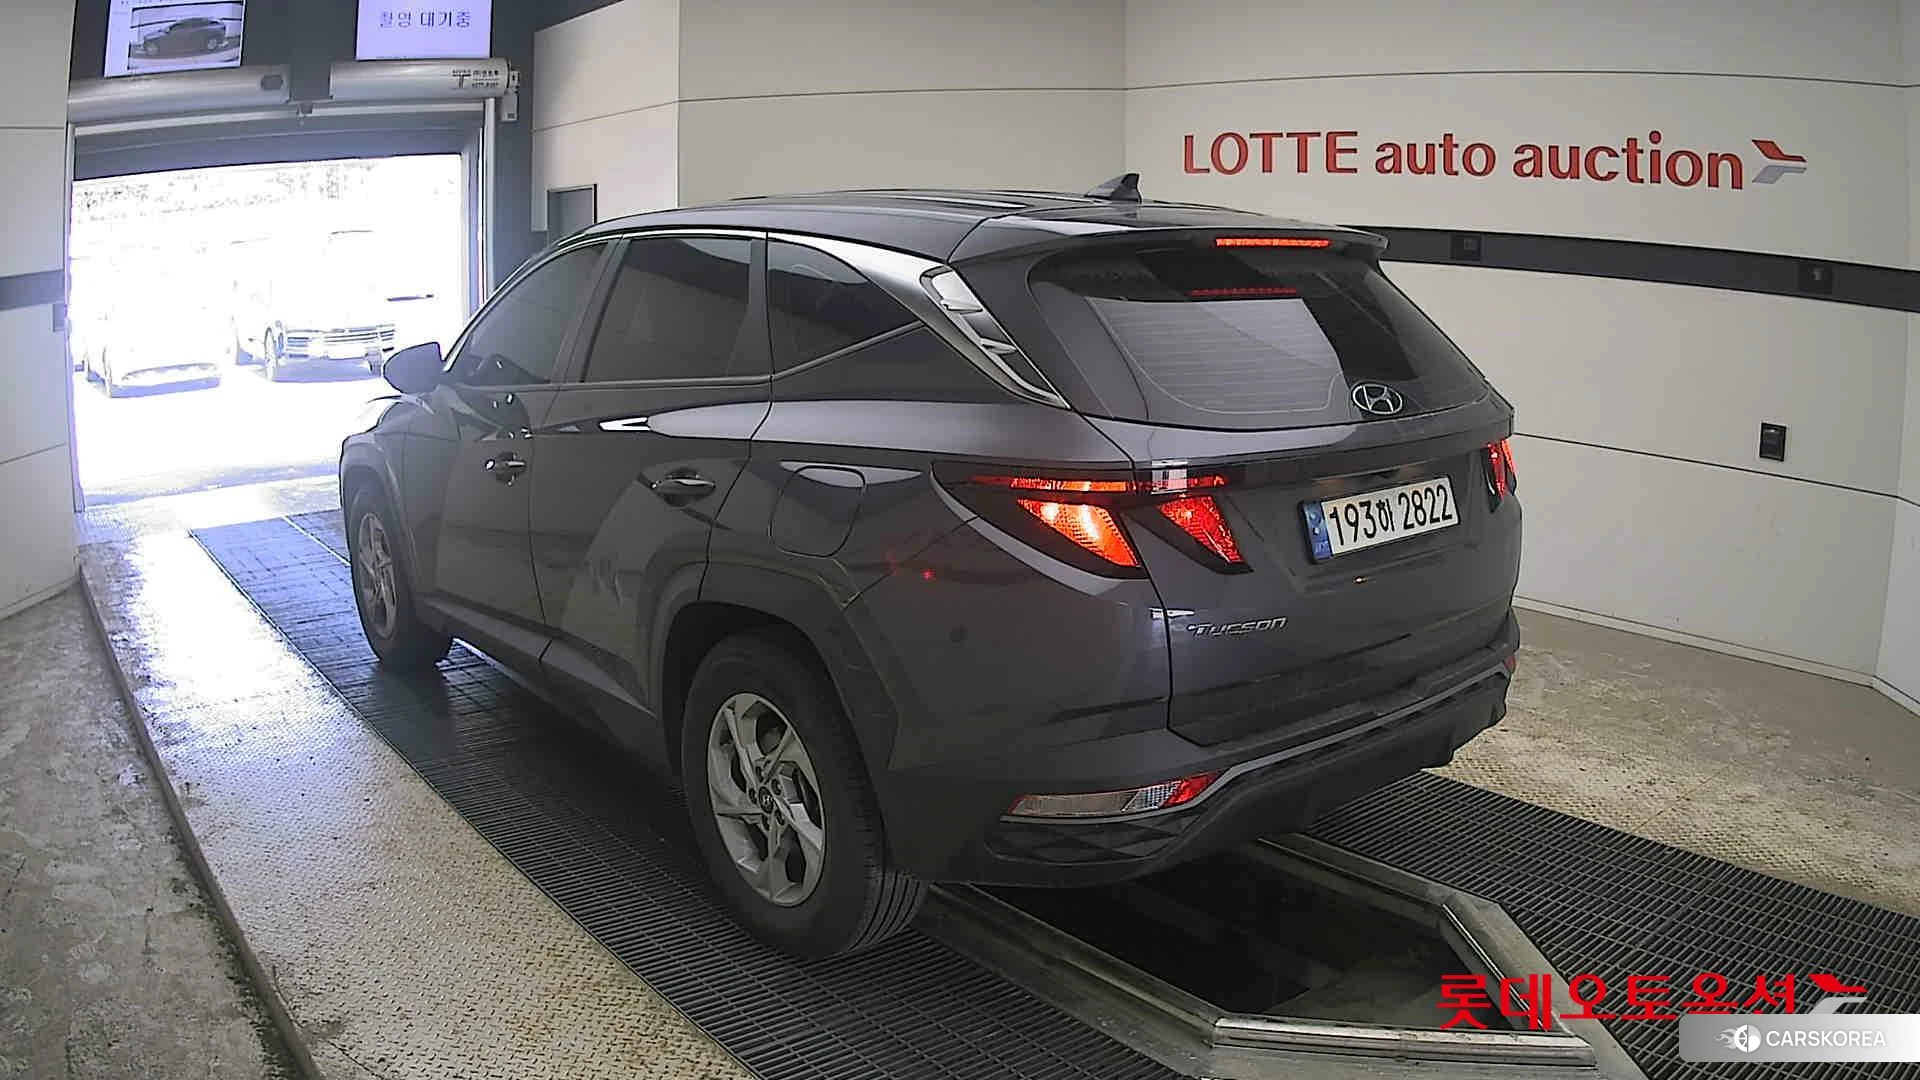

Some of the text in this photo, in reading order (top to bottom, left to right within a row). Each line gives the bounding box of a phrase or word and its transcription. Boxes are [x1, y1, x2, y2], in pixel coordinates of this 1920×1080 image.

[420, 11, 471, 28] 대기중
[1183, 130, 1744, 190] LOTTE auto auction
[1329, 484, 1453, 546] 193하 2822
